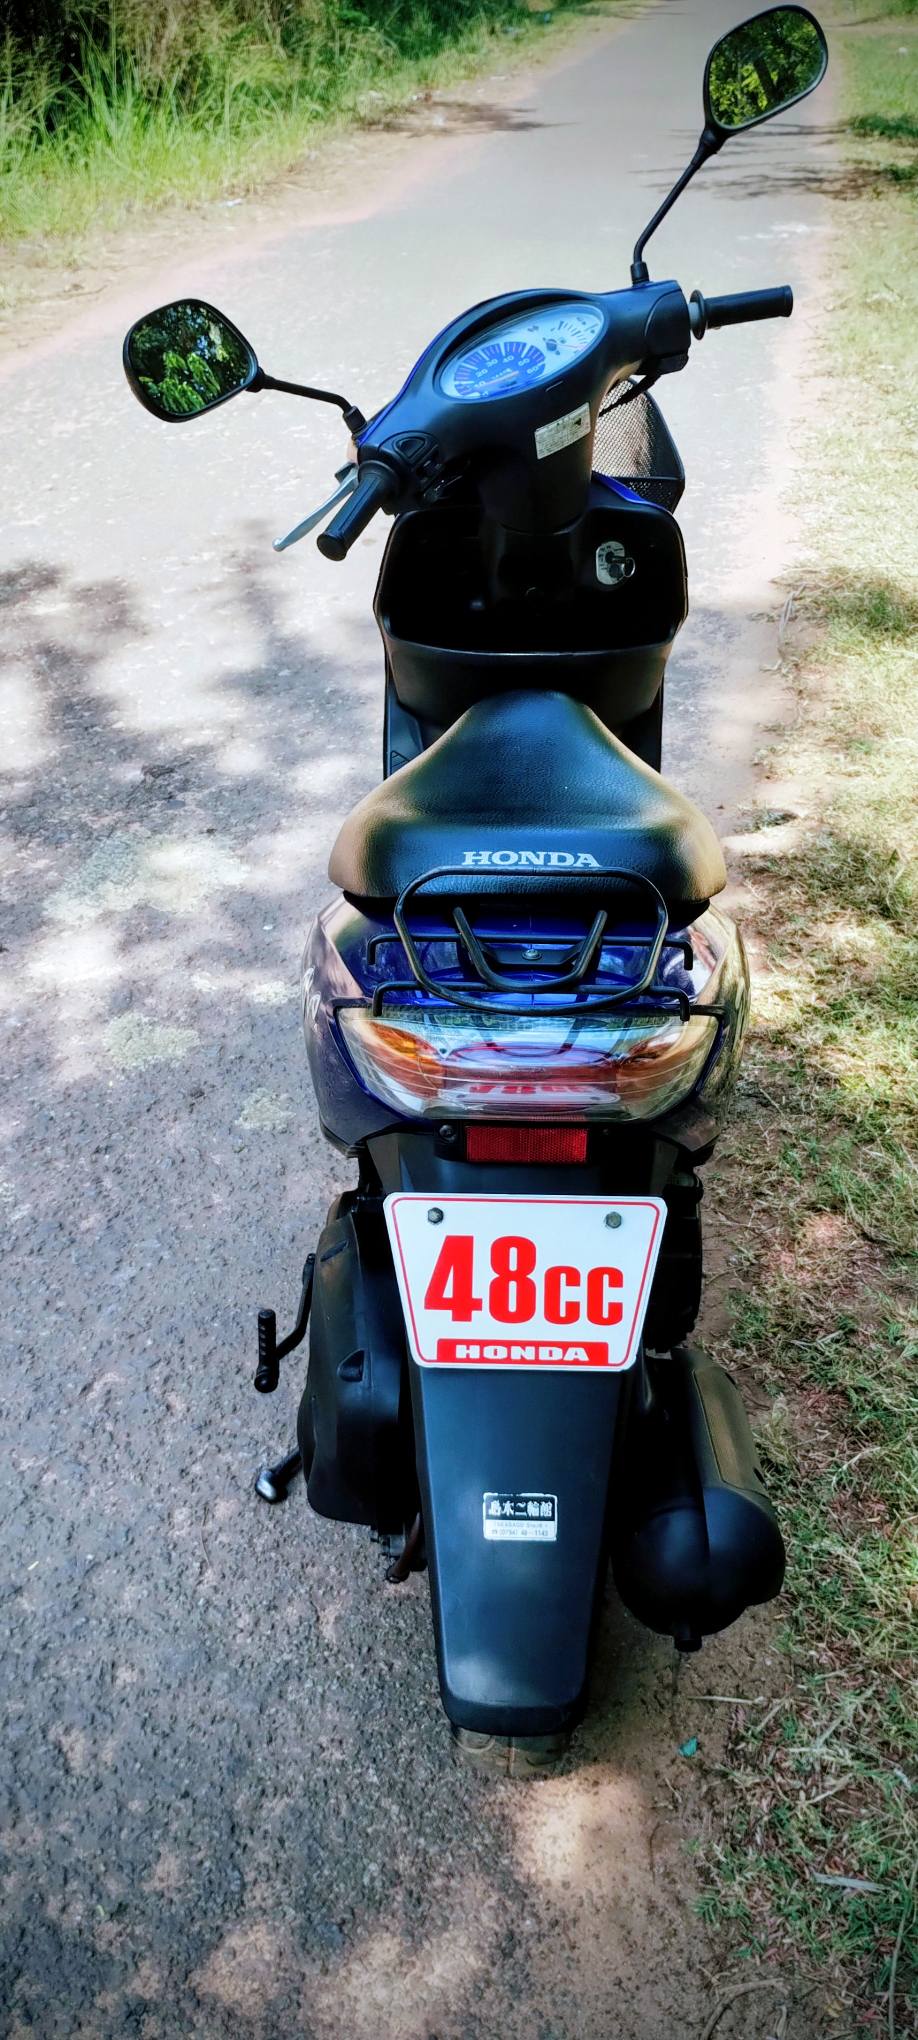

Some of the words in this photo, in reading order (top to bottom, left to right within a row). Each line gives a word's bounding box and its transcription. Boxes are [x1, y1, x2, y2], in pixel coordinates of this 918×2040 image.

[486, 358, 498, 368] 30
[502, 355, 515, 363] 40
[475, 368, 488, 378] 20
[526, 366, 539, 374] 60
[462, 850, 602, 867] HONDA
[455, 1344, 590, 1362] HONDA
